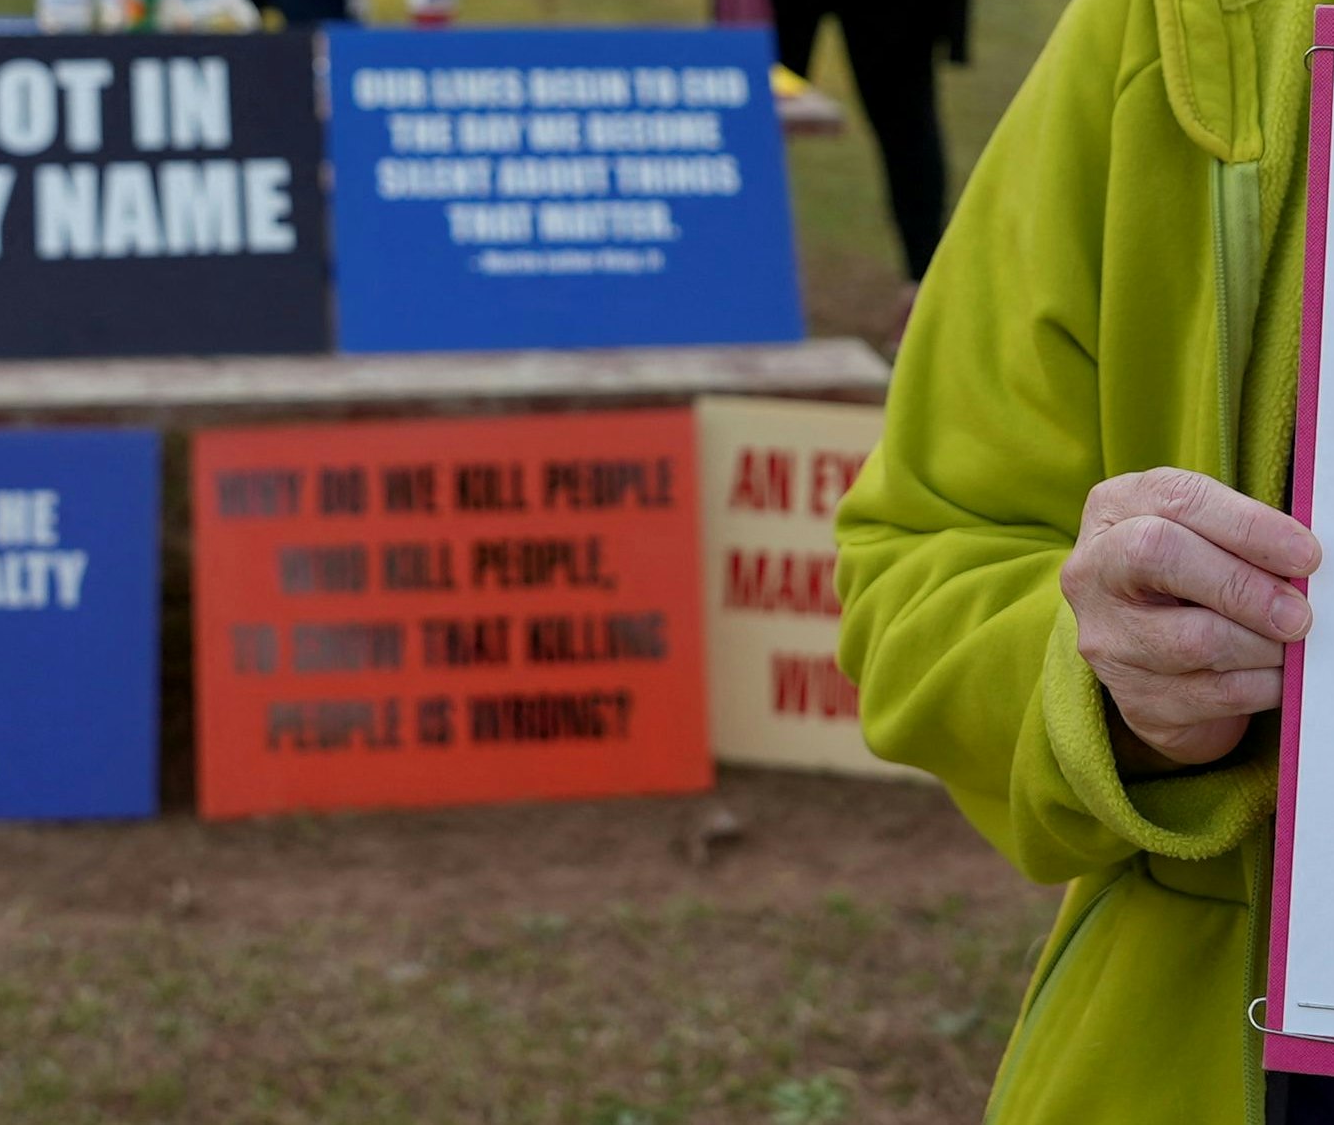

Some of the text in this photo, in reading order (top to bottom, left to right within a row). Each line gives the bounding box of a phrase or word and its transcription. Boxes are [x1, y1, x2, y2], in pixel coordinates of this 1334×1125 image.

[131, 56, 232, 151] IN
[353, 67, 749, 110] OUR LIVES BEGIN TO END
[389, 111, 722, 153] THE DAY WE BECOME
[376, 155, 742, 199] SILENT ABOUT THINGS
[33, 158, 297, 261] NAME
[447, 201, 533, 242] THAT
[214, 456, 674, 520] WHY DO WE KILL PEOPLE
[729, 446, 793, 515] AN
[279, 536, 617, 594] WHO KILL PEOPLE,
[231, 612, 666, 674] TO SHOW THAT KILLING
[268, 689, 633, 752] PEOPLE IS WRONG?
